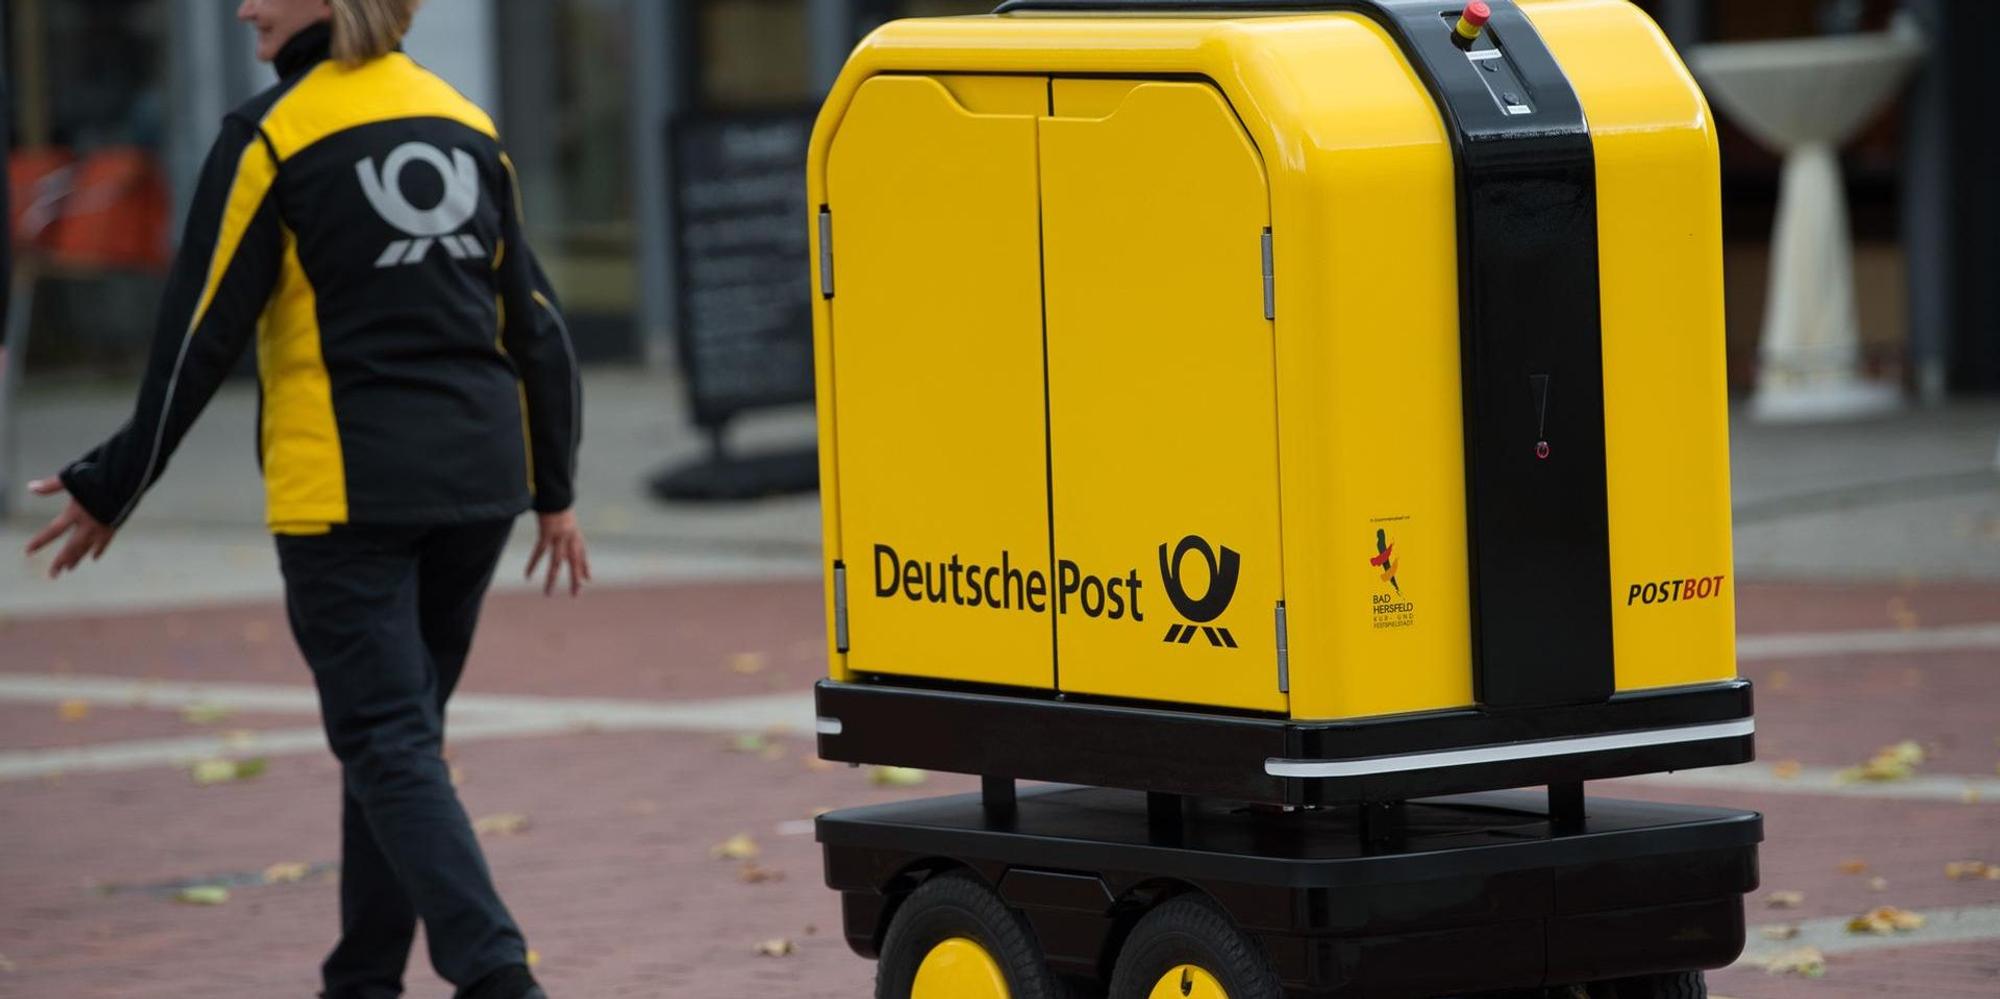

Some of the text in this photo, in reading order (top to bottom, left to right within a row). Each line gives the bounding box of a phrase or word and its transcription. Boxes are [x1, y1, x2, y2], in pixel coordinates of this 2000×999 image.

[874, 543, 1144, 622] Deutsche Post
[1627, 575, 1725, 606] POSTBOT
[1373, 594, 1391, 604] BAD
[1373, 602, 1414, 614] HERSFELD
